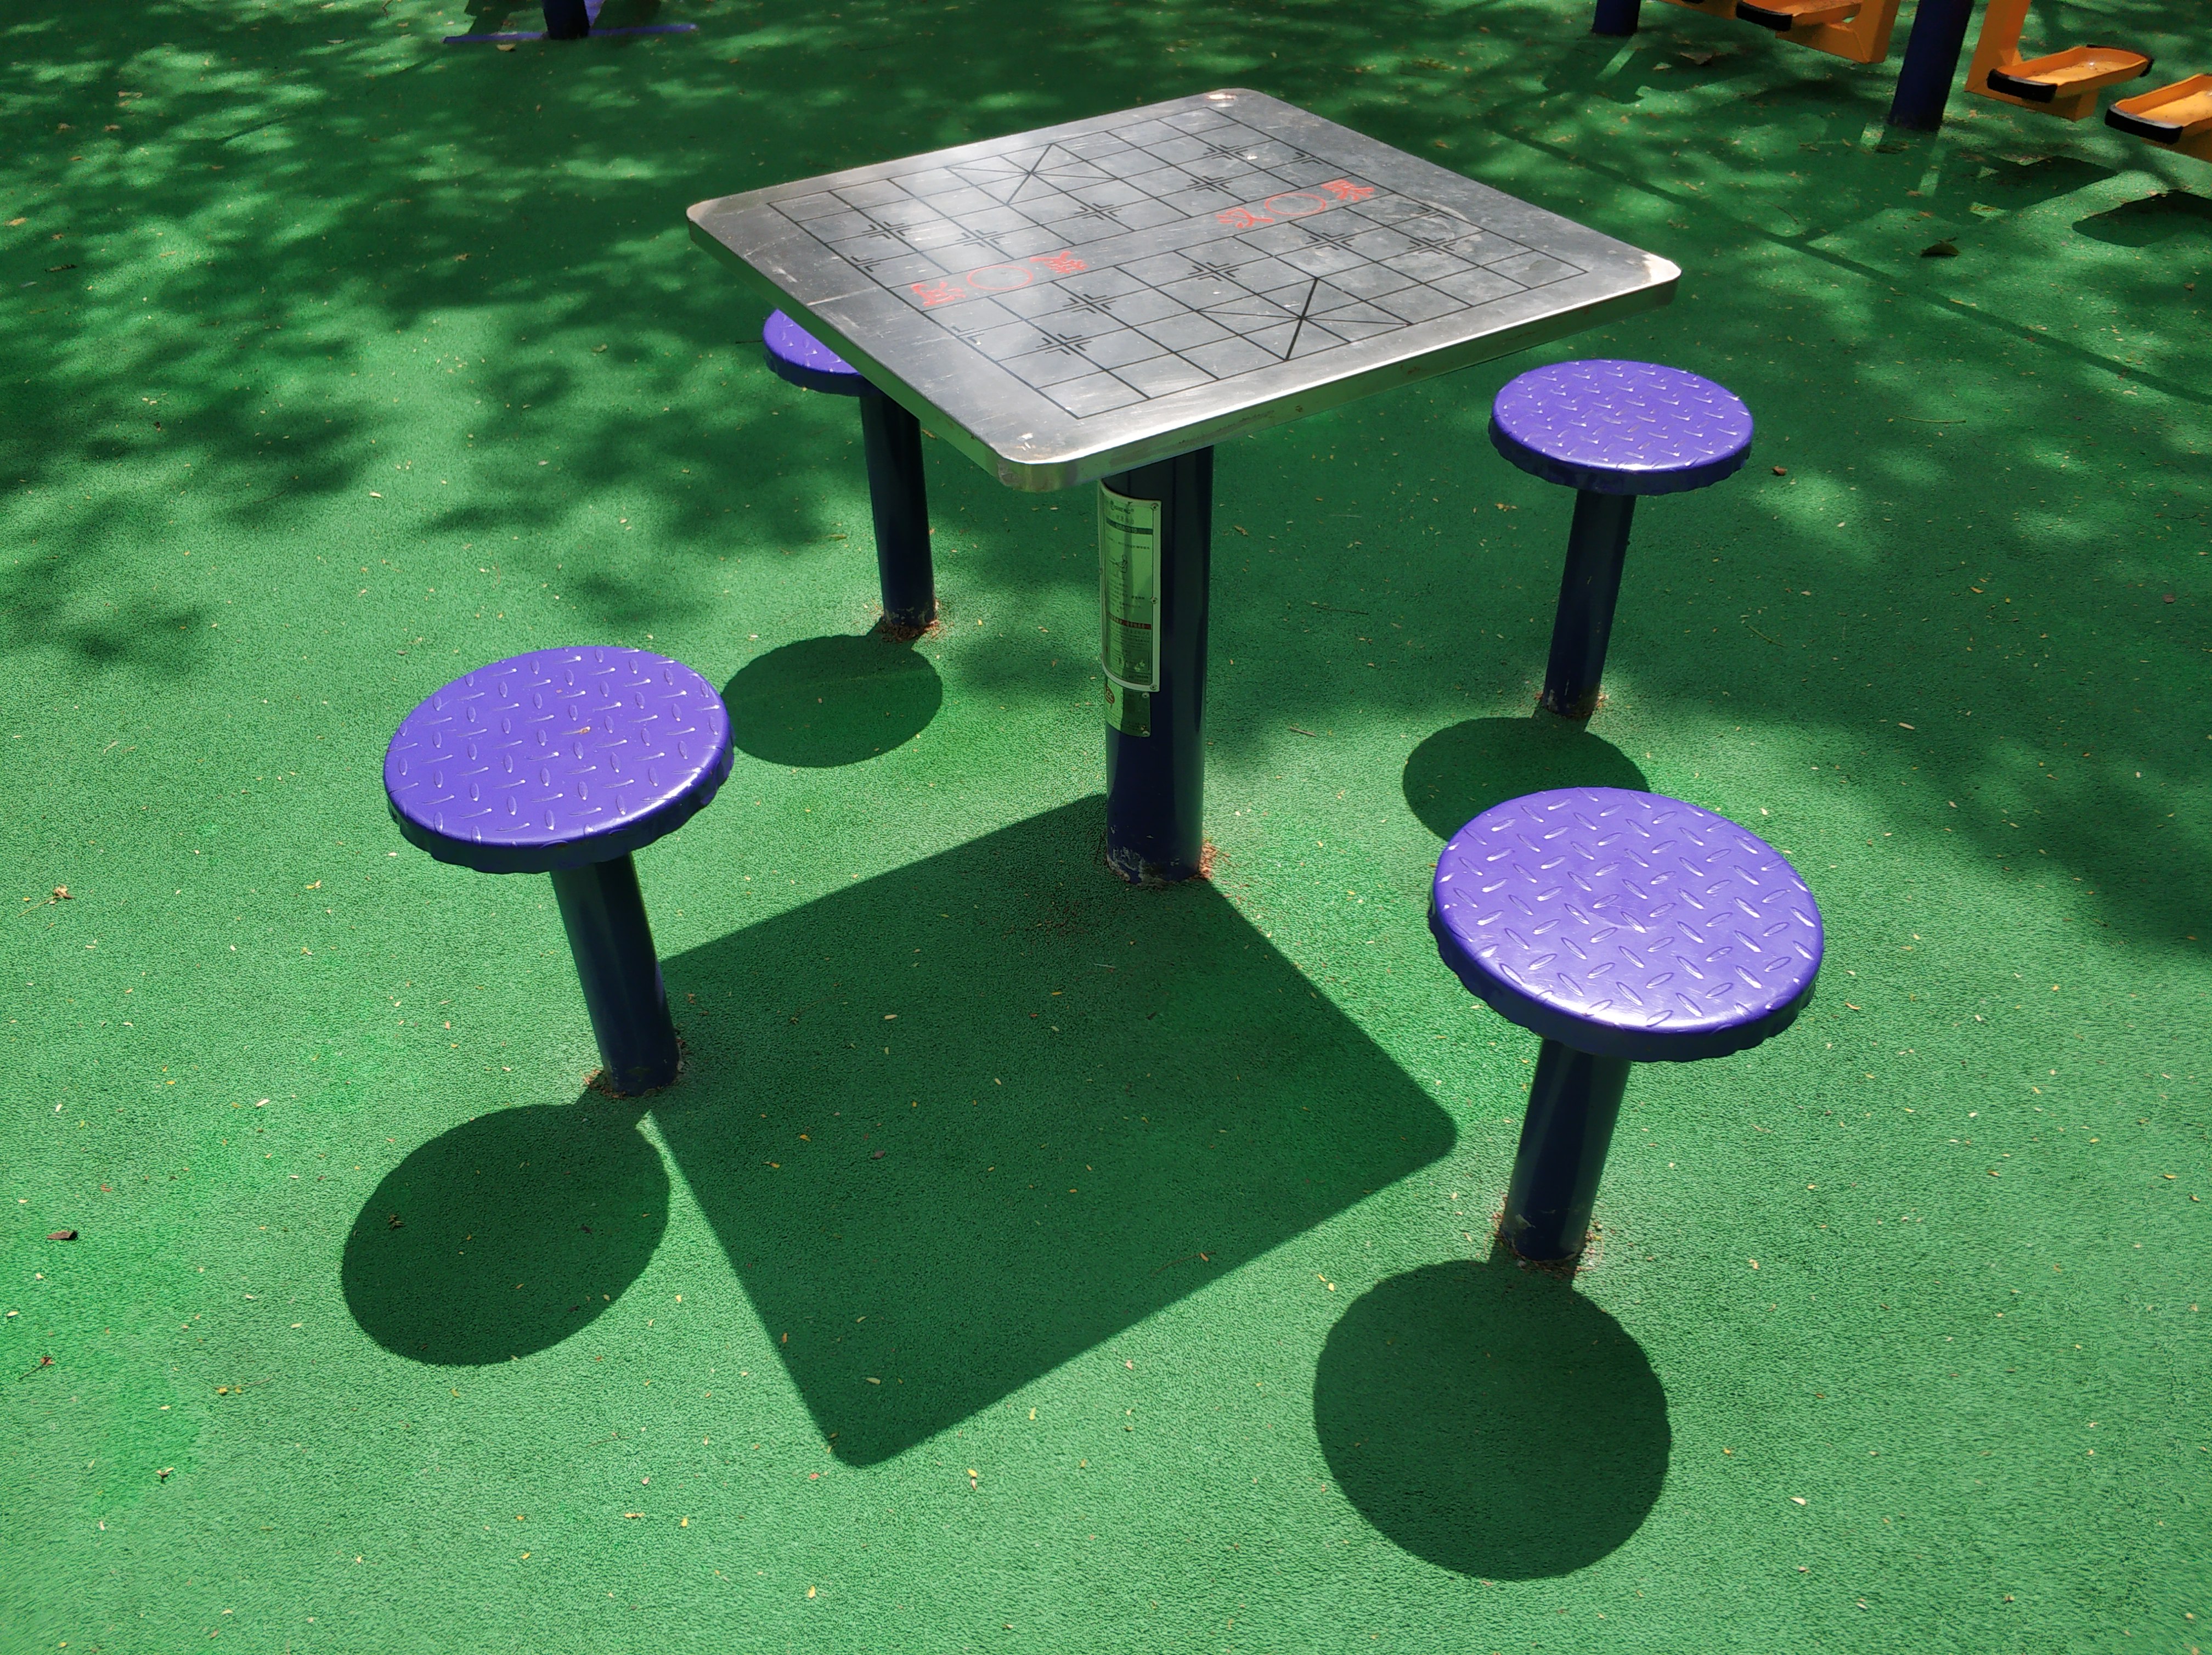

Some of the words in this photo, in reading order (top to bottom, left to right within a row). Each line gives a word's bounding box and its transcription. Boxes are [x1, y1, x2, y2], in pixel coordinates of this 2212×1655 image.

[1216, 207, 1274, 229] 汉
[1321, 179, 1375, 202] 界
[1030, 251, 1088, 275] 楚
[911, 281, 966, 307] 河
